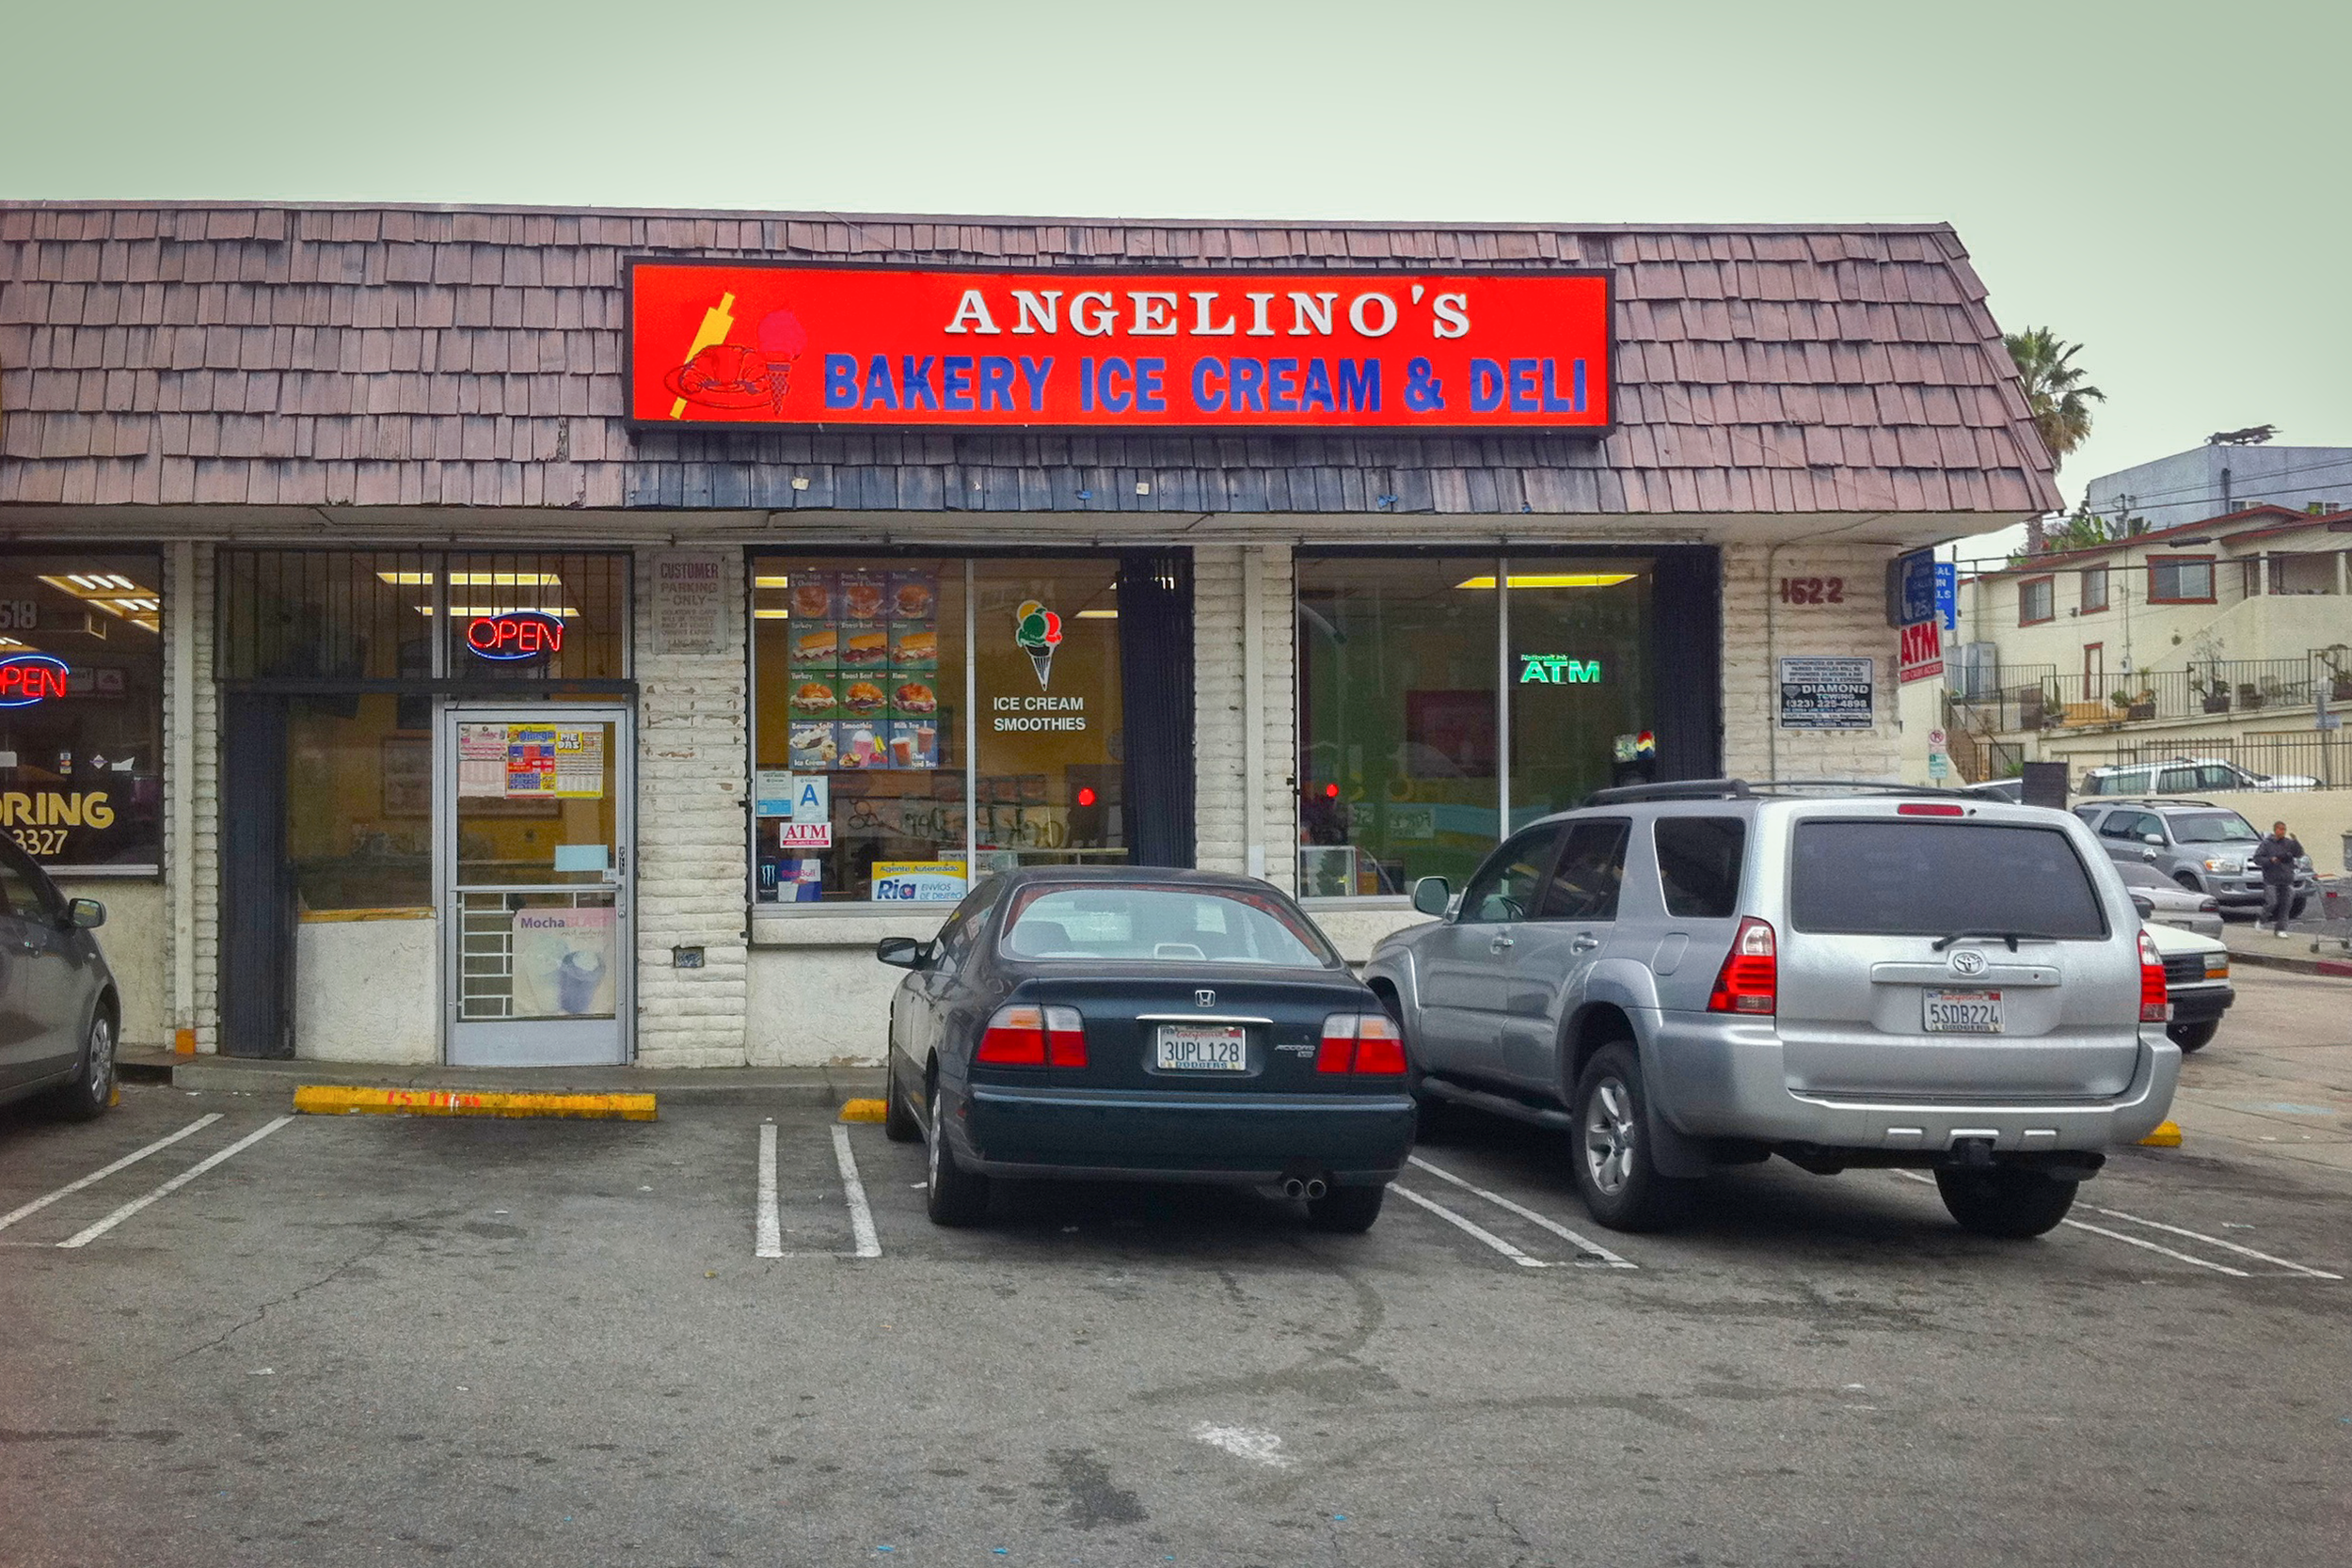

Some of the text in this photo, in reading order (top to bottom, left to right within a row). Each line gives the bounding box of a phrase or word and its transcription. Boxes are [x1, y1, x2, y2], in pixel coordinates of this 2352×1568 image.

[944, 284, 1471, 340] ANGELINO'S
[823, 354, 1587, 414] BAKERY ICE CREAM & DELI
[660, 562, 719, 579] CUSTOMER
[660, 581, 718, 594] PARKING
[673, 594, 707, 607] ONLY
[469, 616, 562, 652] OPEN
[1901, 620, 1941, 667] ATM
[0, 666, 67, 698] PEN
[791, 672, 814, 680] Turkey
[1520, 660, 1600, 683] ATM
[1802, 684, 1869, 694] DIAMOND
[993, 697, 1084, 711] ICE CREAM
[993, 717, 1087, 731] SMOOTHIES
[800, 784, 819, 806] A
[0, 791, 115, 830] RING
[785, 824, 828, 839] ATM
[877, 879, 916, 900] Ria
[920, 892, 963, 900] DE DINERO
[520, 916, 565, 929] Mocha
[1931, 1003, 1999, 1025] 5SDB224
[1165, 1041, 1239, 1063] 3UPL128
